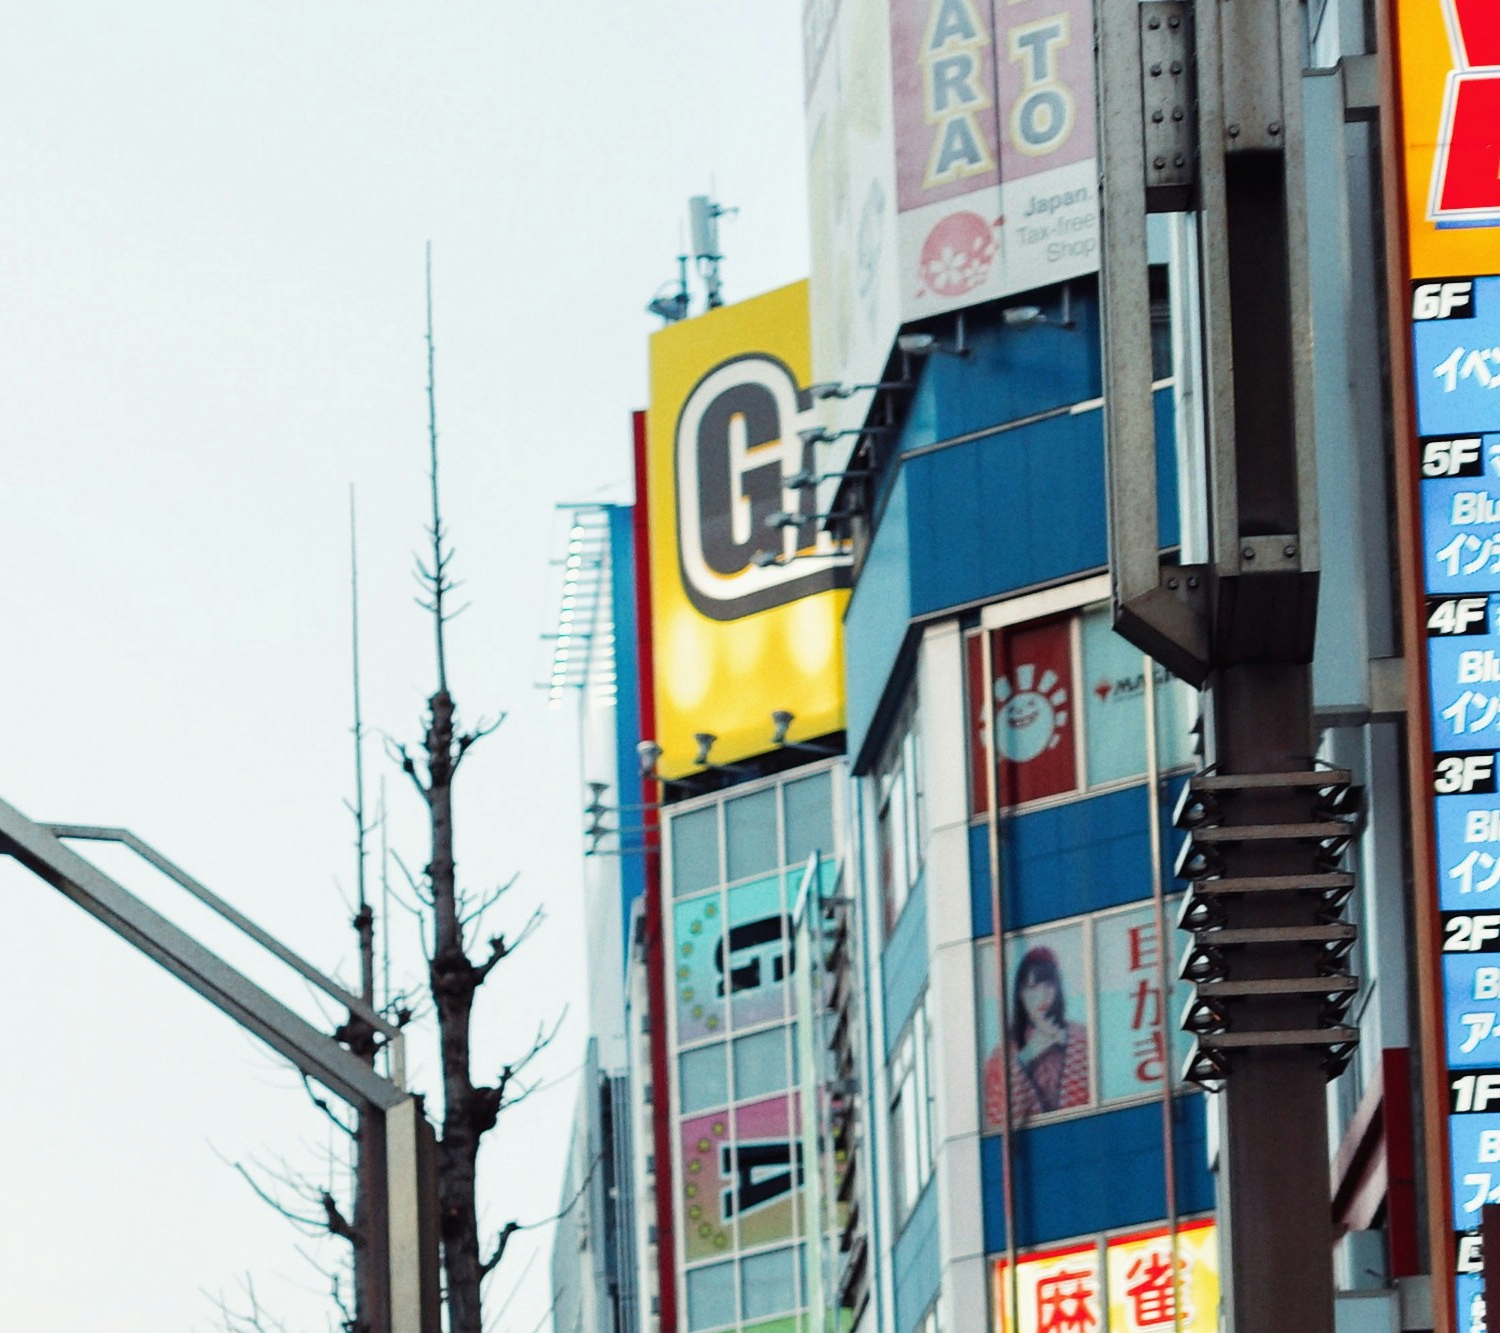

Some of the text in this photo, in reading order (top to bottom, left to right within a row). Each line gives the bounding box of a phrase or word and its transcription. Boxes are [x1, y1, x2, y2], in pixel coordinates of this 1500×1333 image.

[1015, 212, 1095, 247] Tax-free
[1047, 241, 1096, 264] Shop
[1413, 284, 1471, 321] 6F
[1422, 440, 1479, 477] 5F
[1427, 599, 1487, 637] 4F
[1435, 756, 1494, 793] 3F
[1445, 915, 1500, 951] 2F
